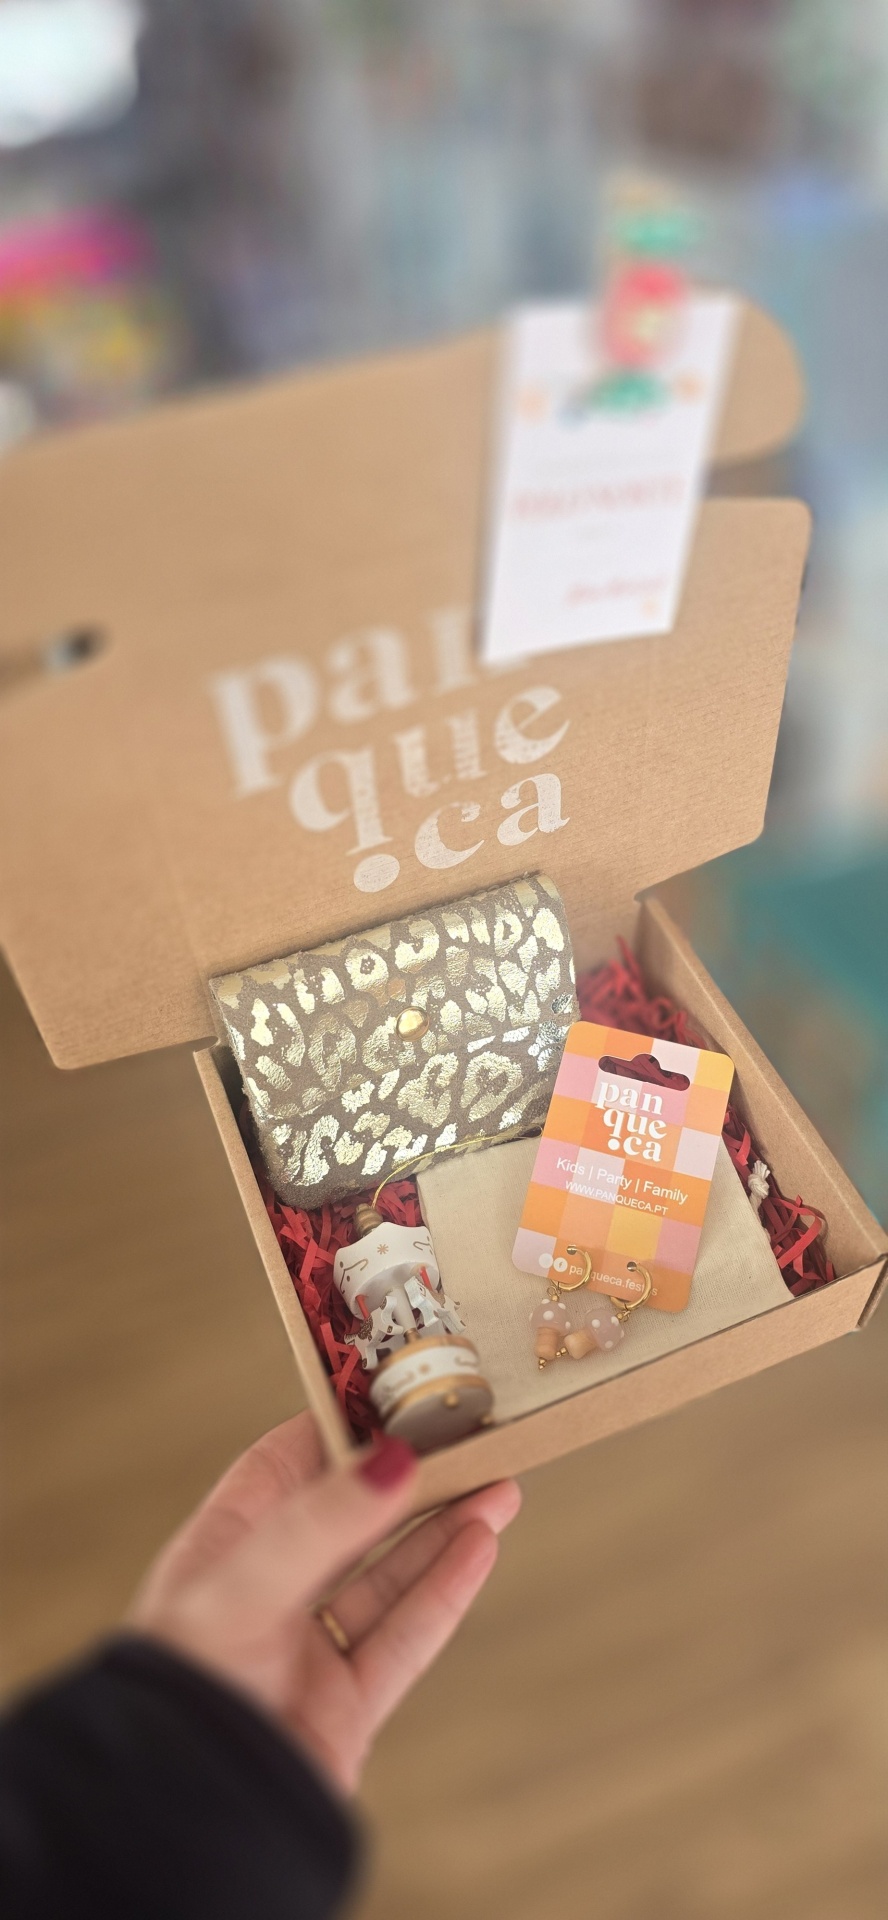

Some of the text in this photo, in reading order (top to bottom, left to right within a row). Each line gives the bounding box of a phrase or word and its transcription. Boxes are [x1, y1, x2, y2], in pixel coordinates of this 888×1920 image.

[289, 684, 571, 856] que
[595, 1082, 663, 1115] pan
[603, 1108, 667, 1139] que
[556, 1157, 585, 1175] Kids
[597, 1168, 632, 1190] Party
[643, 1181, 689, 1205] Family
[565, 1180, 669, 1216] WWW.PANQUECA.PT
[569, 1265, 658, 1297] paqueca.fests
